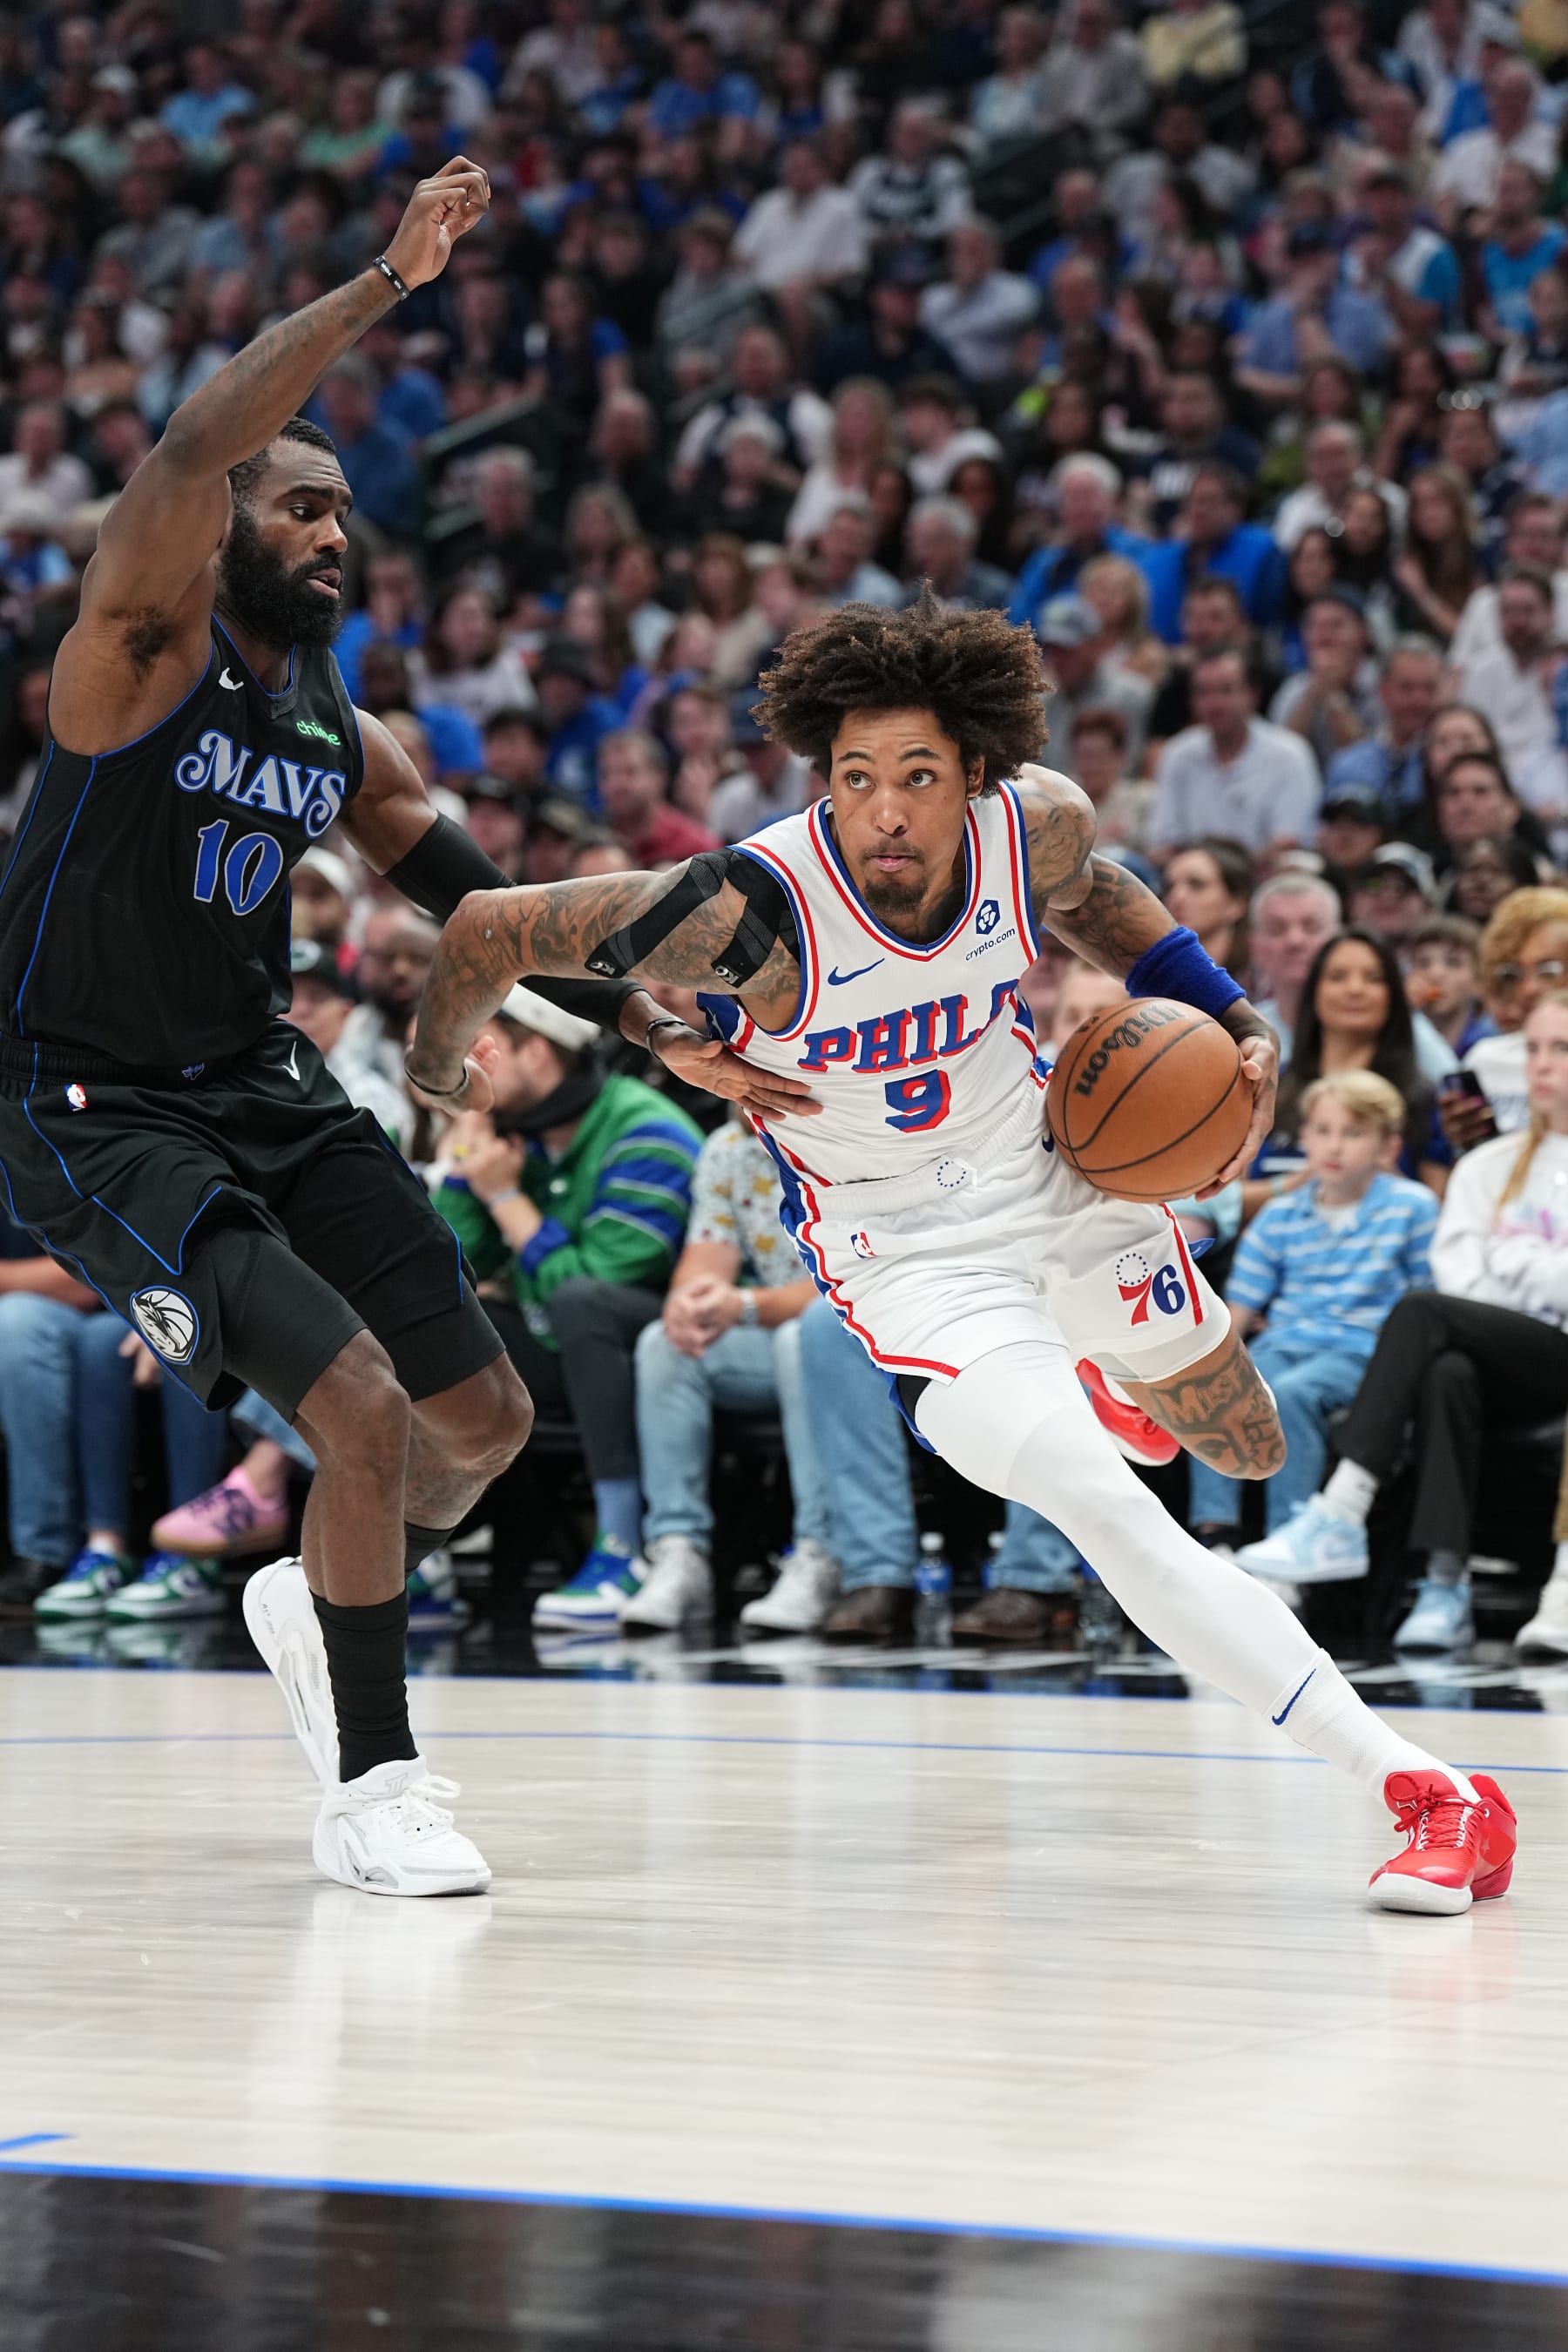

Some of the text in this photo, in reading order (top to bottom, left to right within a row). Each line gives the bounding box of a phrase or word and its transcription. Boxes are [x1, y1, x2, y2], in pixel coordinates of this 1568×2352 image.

[175, 729, 347, 839] MAVS
[193, 818, 284, 916] 10
[965, 928, 1016, 961] crypto.com
[1074, 1003, 1188, 1096] Wilson
[885, 1069, 951, 1132] 9
[1117, 1263, 1186, 1327] 76
